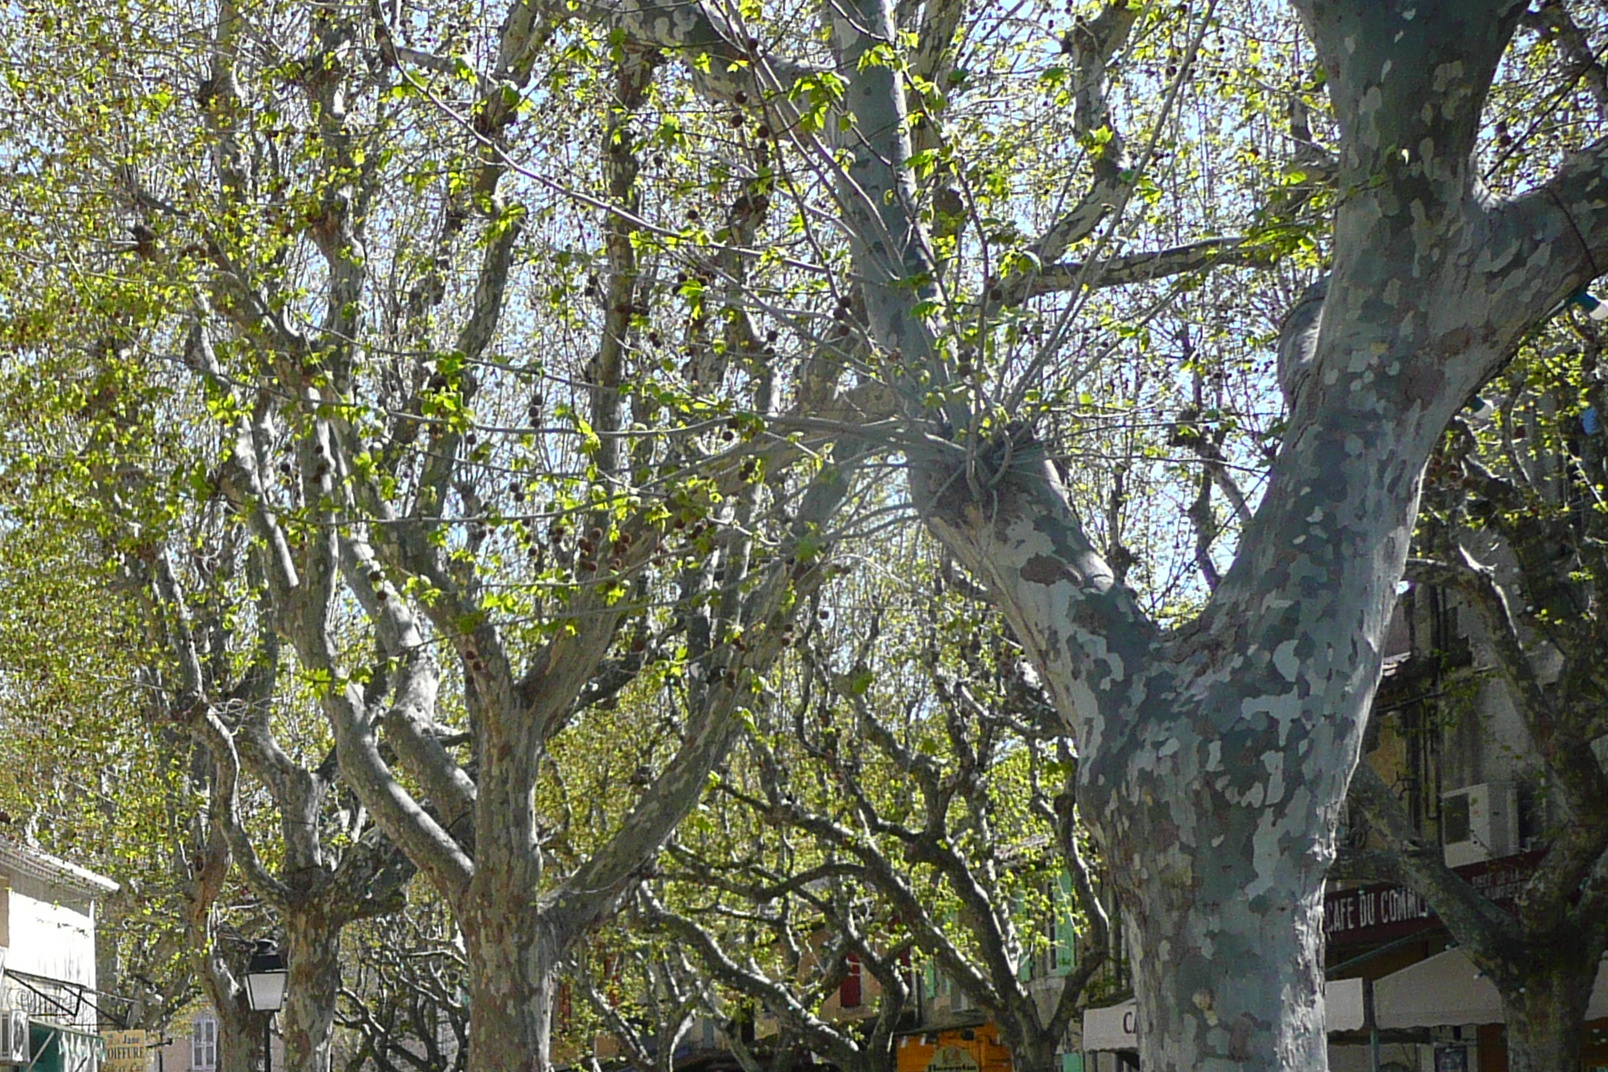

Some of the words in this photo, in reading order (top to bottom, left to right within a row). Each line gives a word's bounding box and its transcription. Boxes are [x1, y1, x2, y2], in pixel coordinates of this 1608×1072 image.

[1359, 891, 1375, 927] DU
[1123, 1011, 1137, 1034] C
[104, 1046, 144, 1060] OIFFURE
